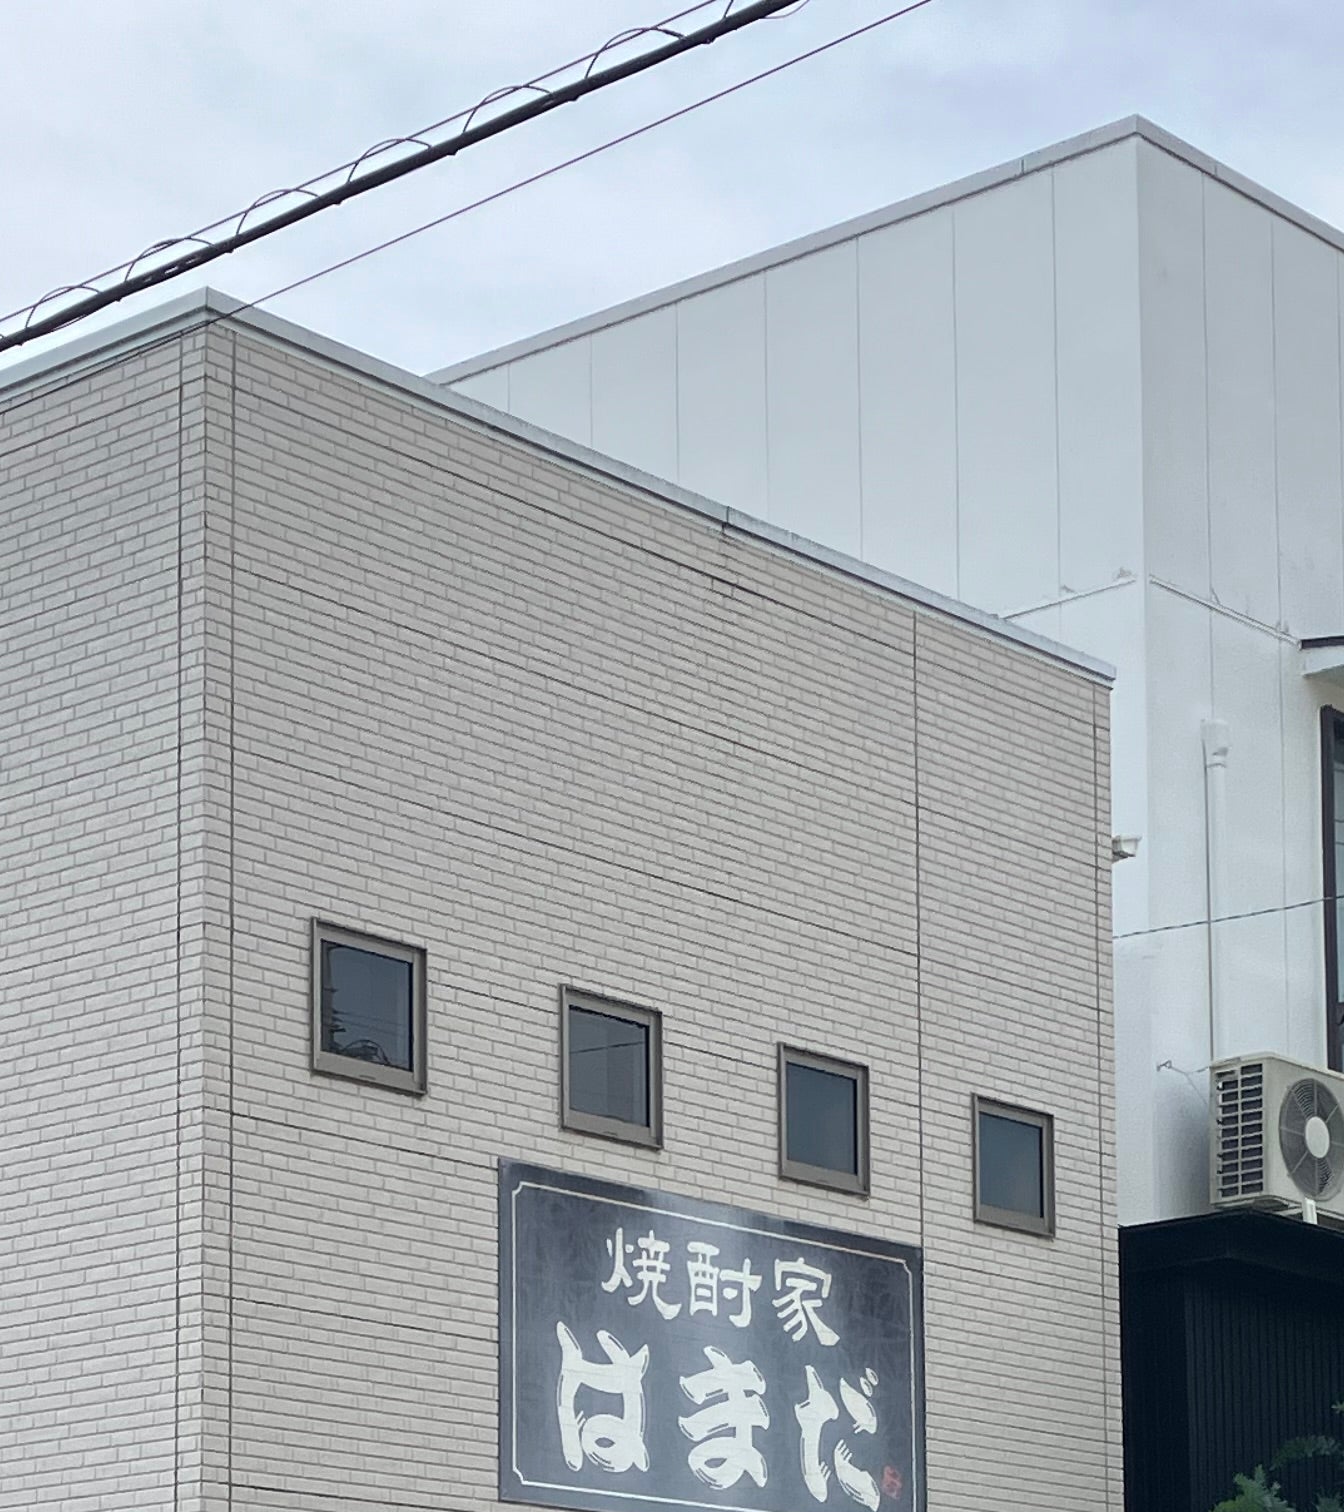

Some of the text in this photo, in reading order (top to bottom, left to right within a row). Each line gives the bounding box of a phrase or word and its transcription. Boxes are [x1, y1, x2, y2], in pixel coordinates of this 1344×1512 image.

[601, 1226, 840, 1346] 焼酎家
[556, 1321, 880, 1512] はまだ
